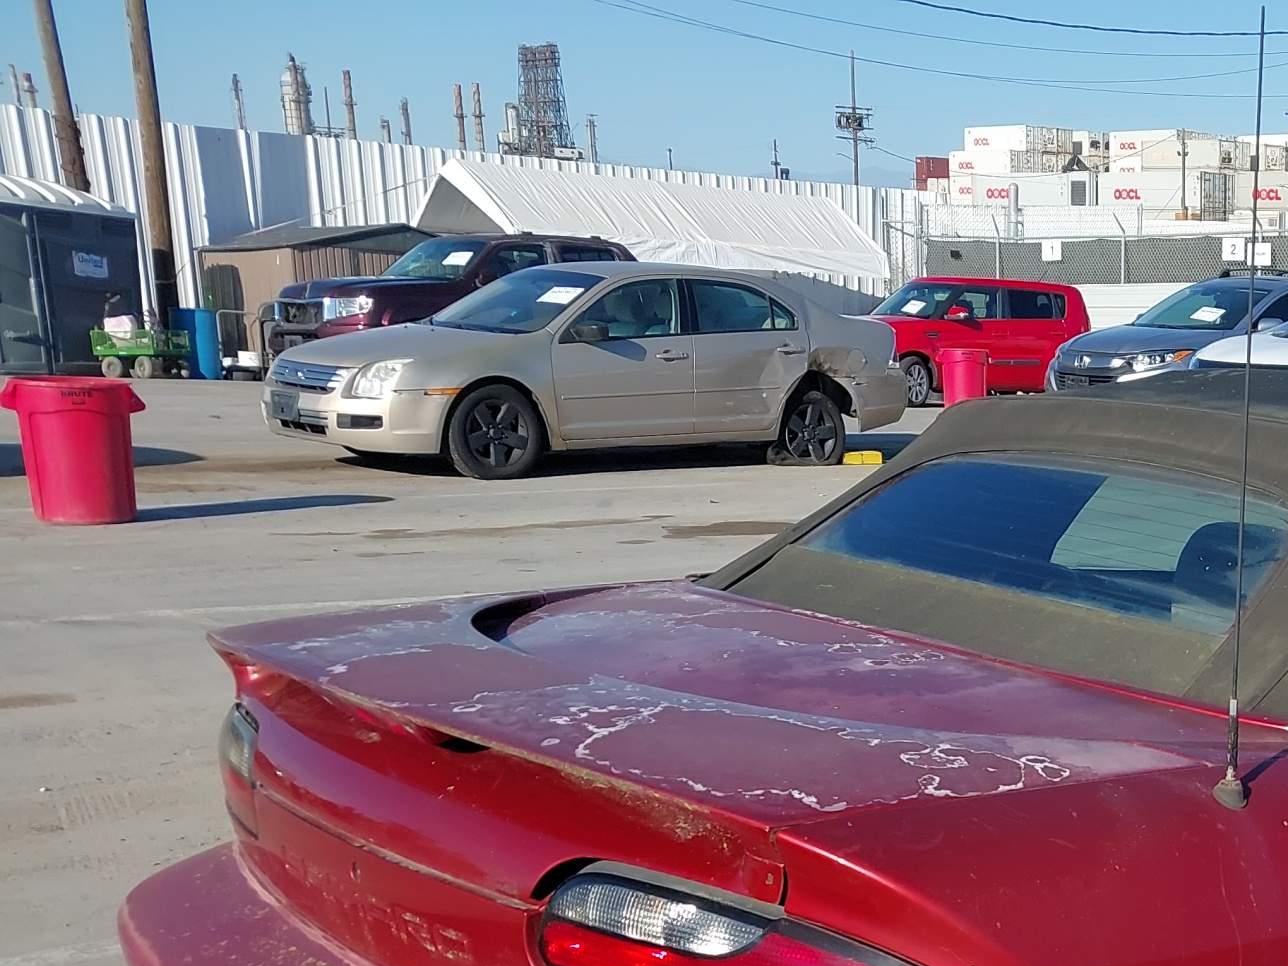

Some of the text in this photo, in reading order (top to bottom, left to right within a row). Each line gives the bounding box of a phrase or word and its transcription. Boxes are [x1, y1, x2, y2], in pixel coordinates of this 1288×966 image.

[1119, 142, 1137, 150] OOCL
[958, 161, 975, 170] OOCL
[1113, 188, 1141, 200] OOCL
[1252, 188, 1282, 201] OOCL
[1230, 243, 1237, 255] 2
